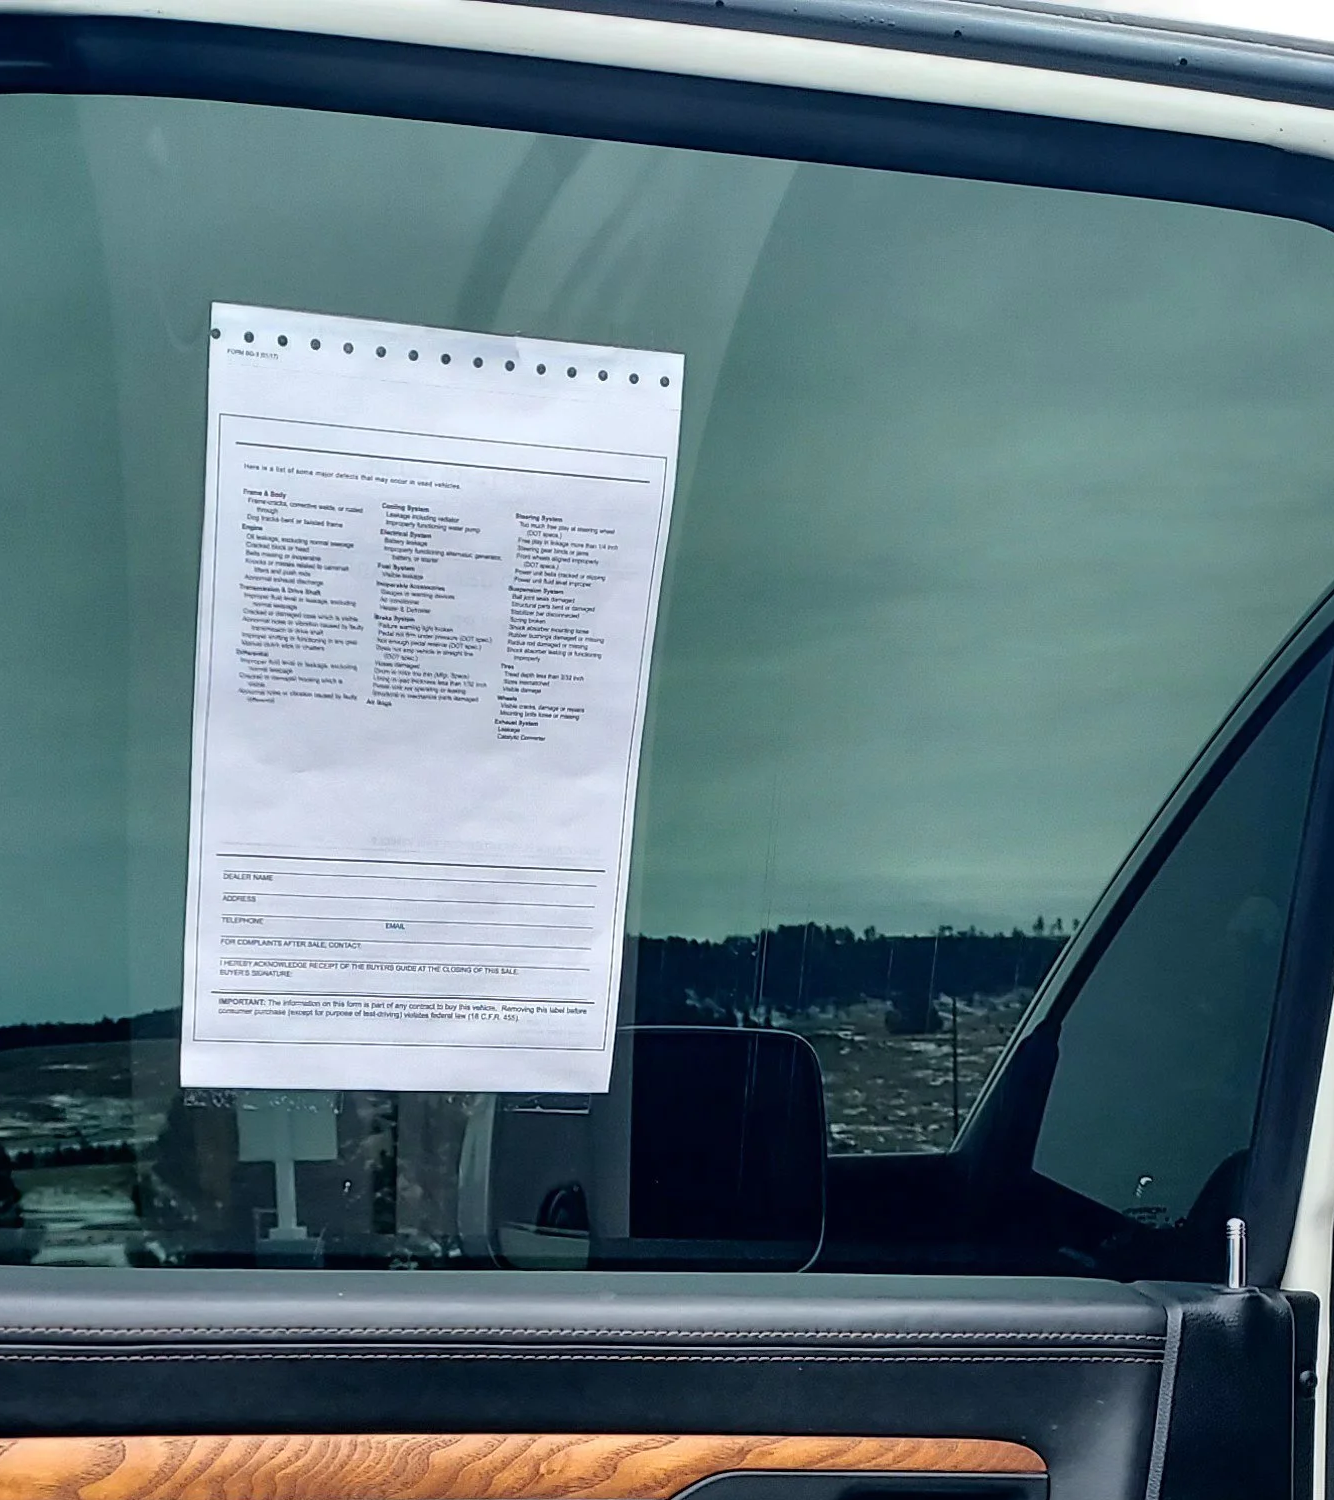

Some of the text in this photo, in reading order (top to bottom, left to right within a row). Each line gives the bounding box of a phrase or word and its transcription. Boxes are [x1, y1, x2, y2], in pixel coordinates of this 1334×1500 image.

[222, 872, 251, 880] DEALER
[222, 894, 256, 902] ADDRESS
[221, 916, 264, 924] TELEPHONE
[236, 938, 282, 946] COMPLAINTS
[253, 960, 307, 968] ACKNOWLEDGE
[441, 965, 472, 973] CLOSING
[218, 997, 266, 1005] IMPORTANT:
[267, 998, 281, 1006] The
[370, 1000, 385, 1008] part
[444, 1003, 457, 1011] buy
[362, 1010, 402, 1018] test-driving)
